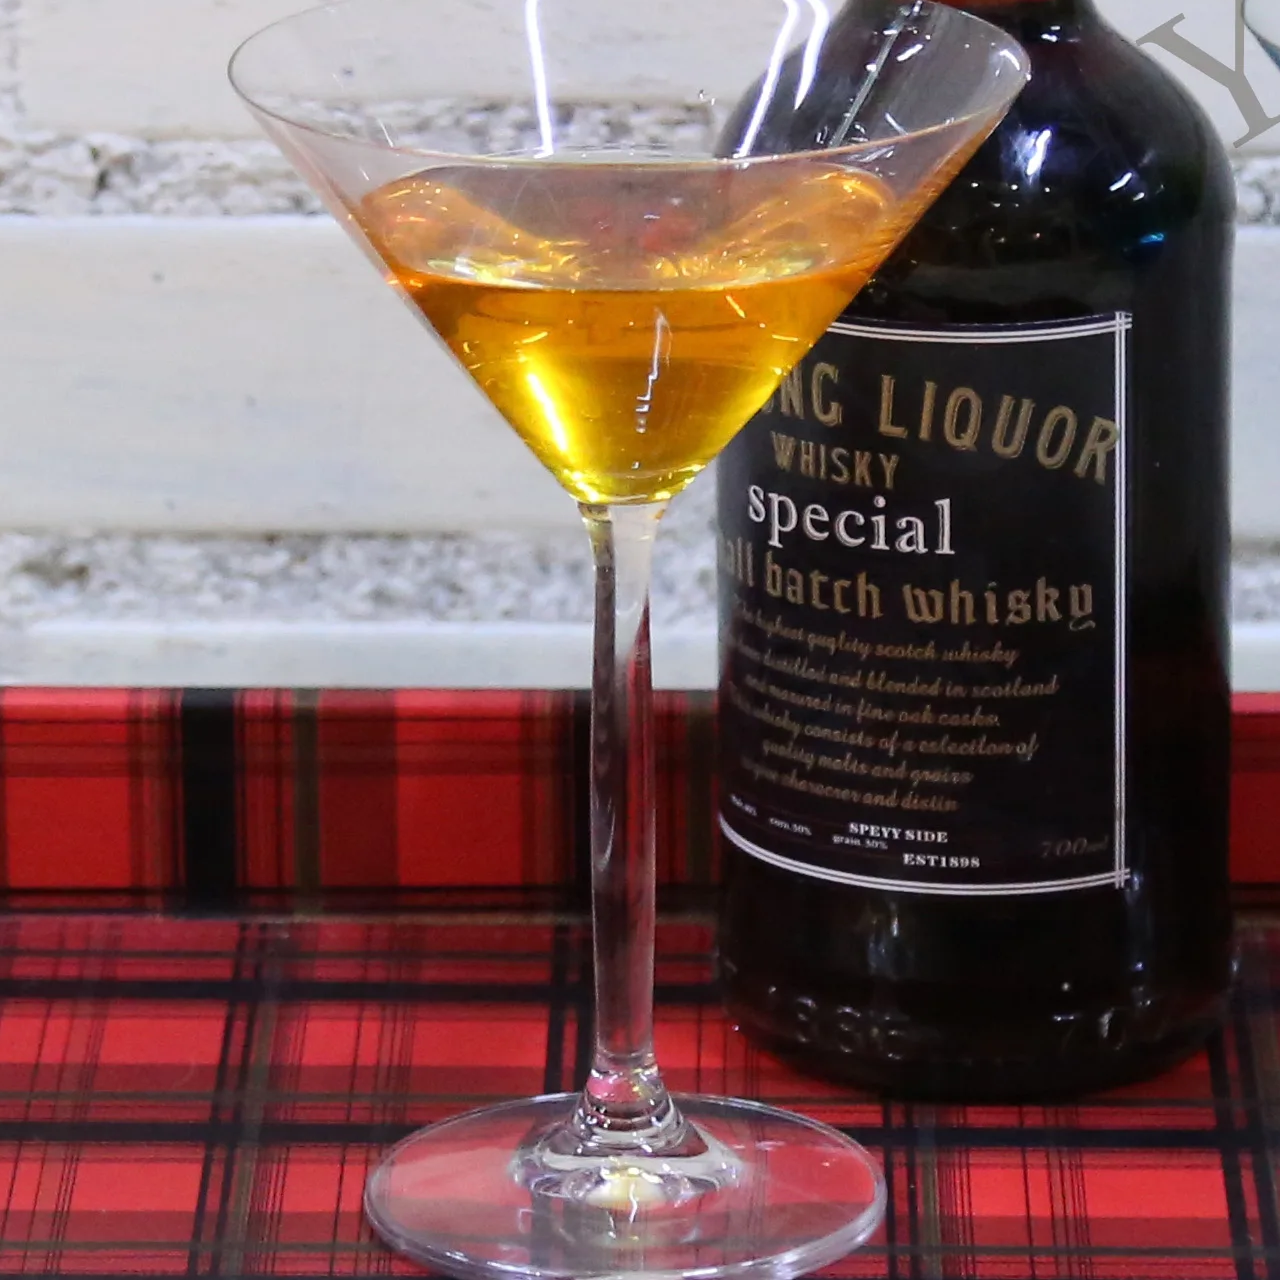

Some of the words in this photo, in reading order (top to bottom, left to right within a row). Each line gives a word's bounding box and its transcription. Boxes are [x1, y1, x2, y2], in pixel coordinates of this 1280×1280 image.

[761, 360, 843, 426] NG
[878, 374, 1121, 487] LIQUOR
[771, 430, 900, 489] WHISKY
[747, 484, 956, 556] special
[765, 551, 884, 619] batch
[902, 575, 1097, 632] whisky
[866, 669, 942, 698] blended
[971, 673, 1060, 699] scotland
[848, 822, 902, 841] SPEYY
[904, 828, 949, 844] SIDE
[902, 852, 981, 869] EST1898
